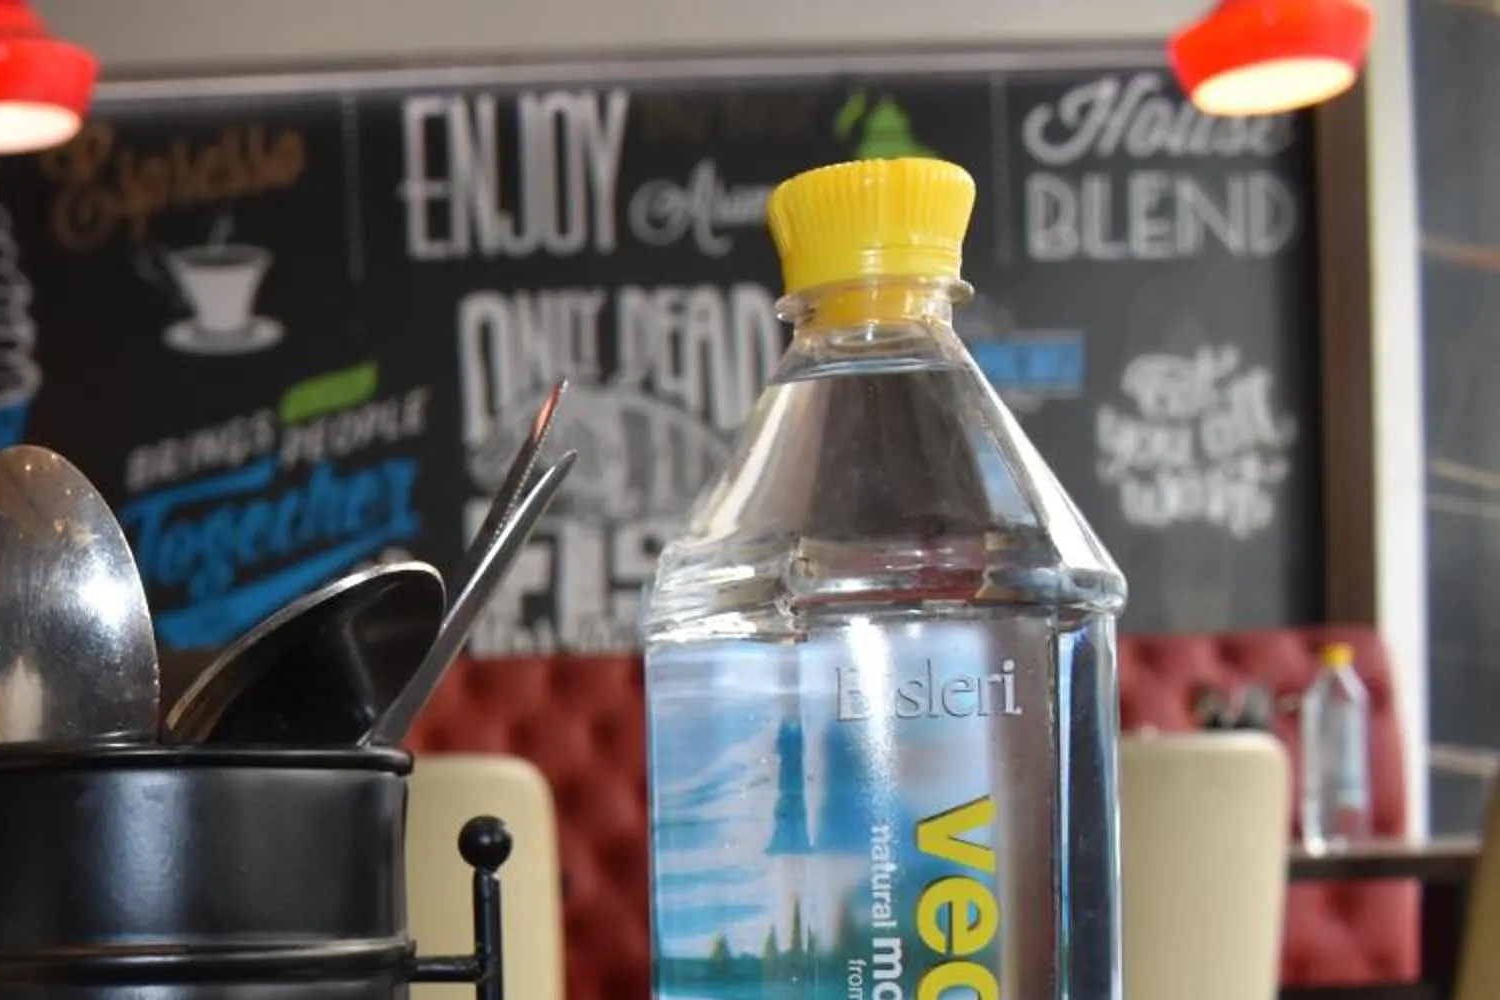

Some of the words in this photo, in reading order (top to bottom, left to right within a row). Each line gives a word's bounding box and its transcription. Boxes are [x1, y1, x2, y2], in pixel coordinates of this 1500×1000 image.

[398, 88, 630, 261] ENJOY
[1024, 168, 1297, 262] BLEND
[835, 657, 1022, 723] Bsleri
[870, 825, 899, 928] natural
